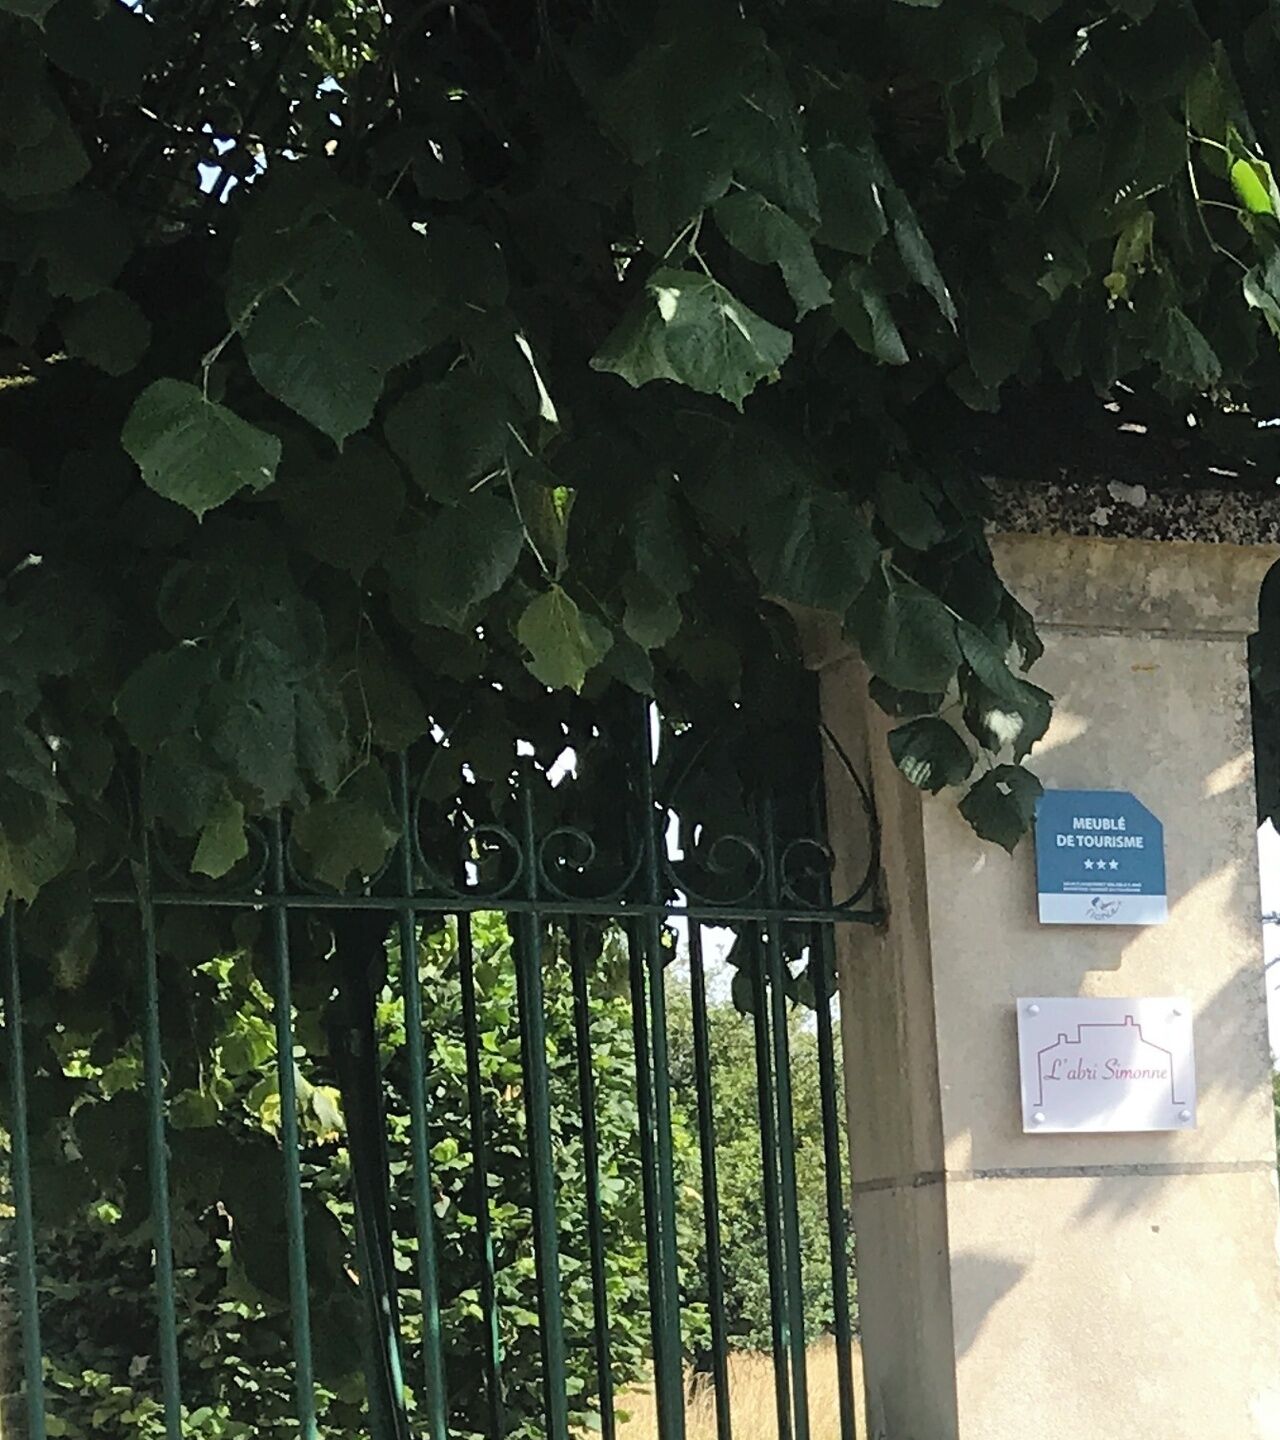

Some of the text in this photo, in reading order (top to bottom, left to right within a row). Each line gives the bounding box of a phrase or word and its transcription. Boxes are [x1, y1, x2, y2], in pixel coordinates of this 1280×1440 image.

[1073, 816, 1126, 831] MEUBLÉ
[1056, 834, 1144, 849] DE TOURISME
[1043, 1057, 1168, 1081] L'abri Simonne
